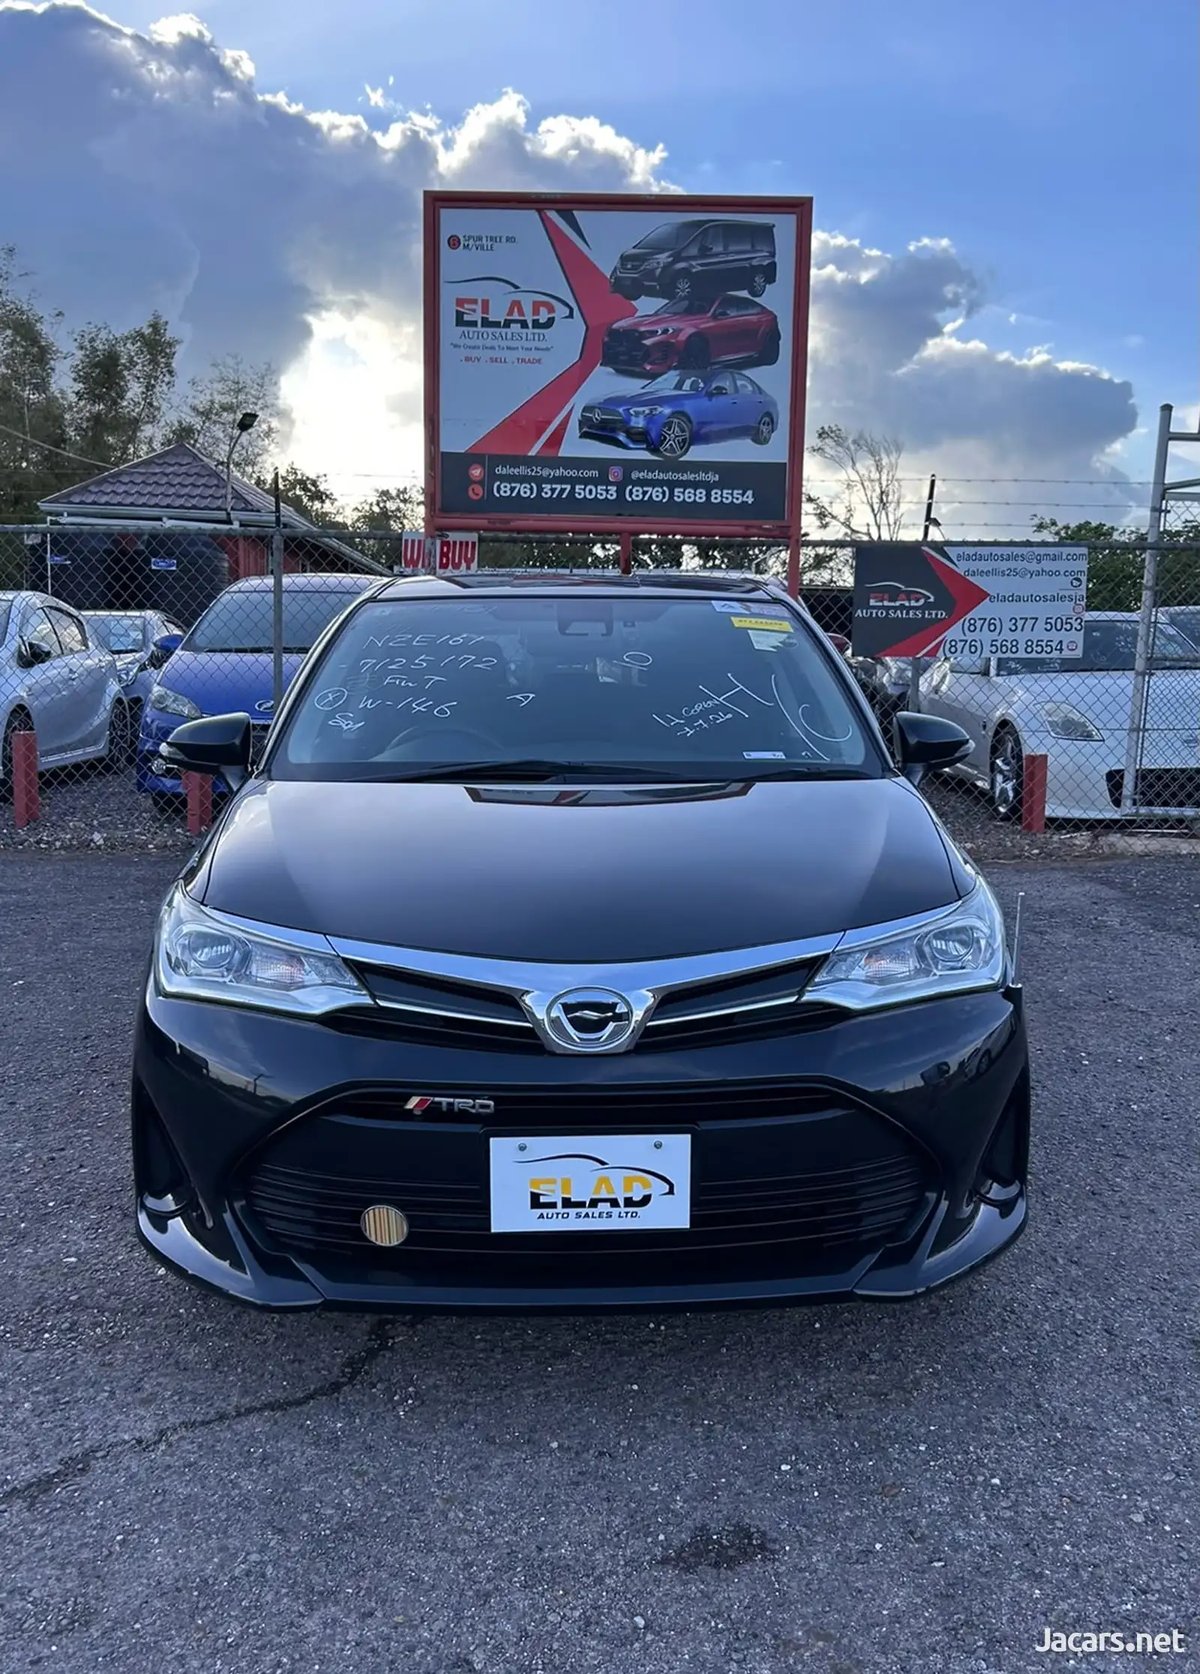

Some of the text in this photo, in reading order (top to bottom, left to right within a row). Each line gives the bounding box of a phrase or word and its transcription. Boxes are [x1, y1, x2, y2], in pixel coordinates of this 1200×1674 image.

[462, 234, 483, 243] SPUR
[485, 235, 503, 243] TREE
[455, 297, 556, 330] ELAD
[459, 330, 548, 342] AUTO SALES LTD.
[495, 465, 599, 478] daleellis25@yahoo.com
[631, 469, 720, 483] @eladautosalesltdja
[493, 481, 754, 504] (876) 377 5053 (876) 568 8554
[438, 540, 477, 571] BUY
[956, 551, 1087, 564] eladautosales@gmail.com
[963, 567, 1086, 579] daleellis25@yahoo.com
[869, 592, 926, 606] ELAD
[989, 592, 1085, 605] eladautosalesja
[854, 609, 949, 619] AUTO SALES LTD.
[961, 616, 1084, 637] (876) 377 5053
[362, 633, 485, 649] NZE161
[942, 639, 1064, 658] (876) 568 8554
[359, 654, 498, 673] 7125172
[433, 1097, 495, 1113] TRD
[529, 1175, 653, 1210] ELAD
[537, 1210, 641, 1220] AUTO SALES LTD.
